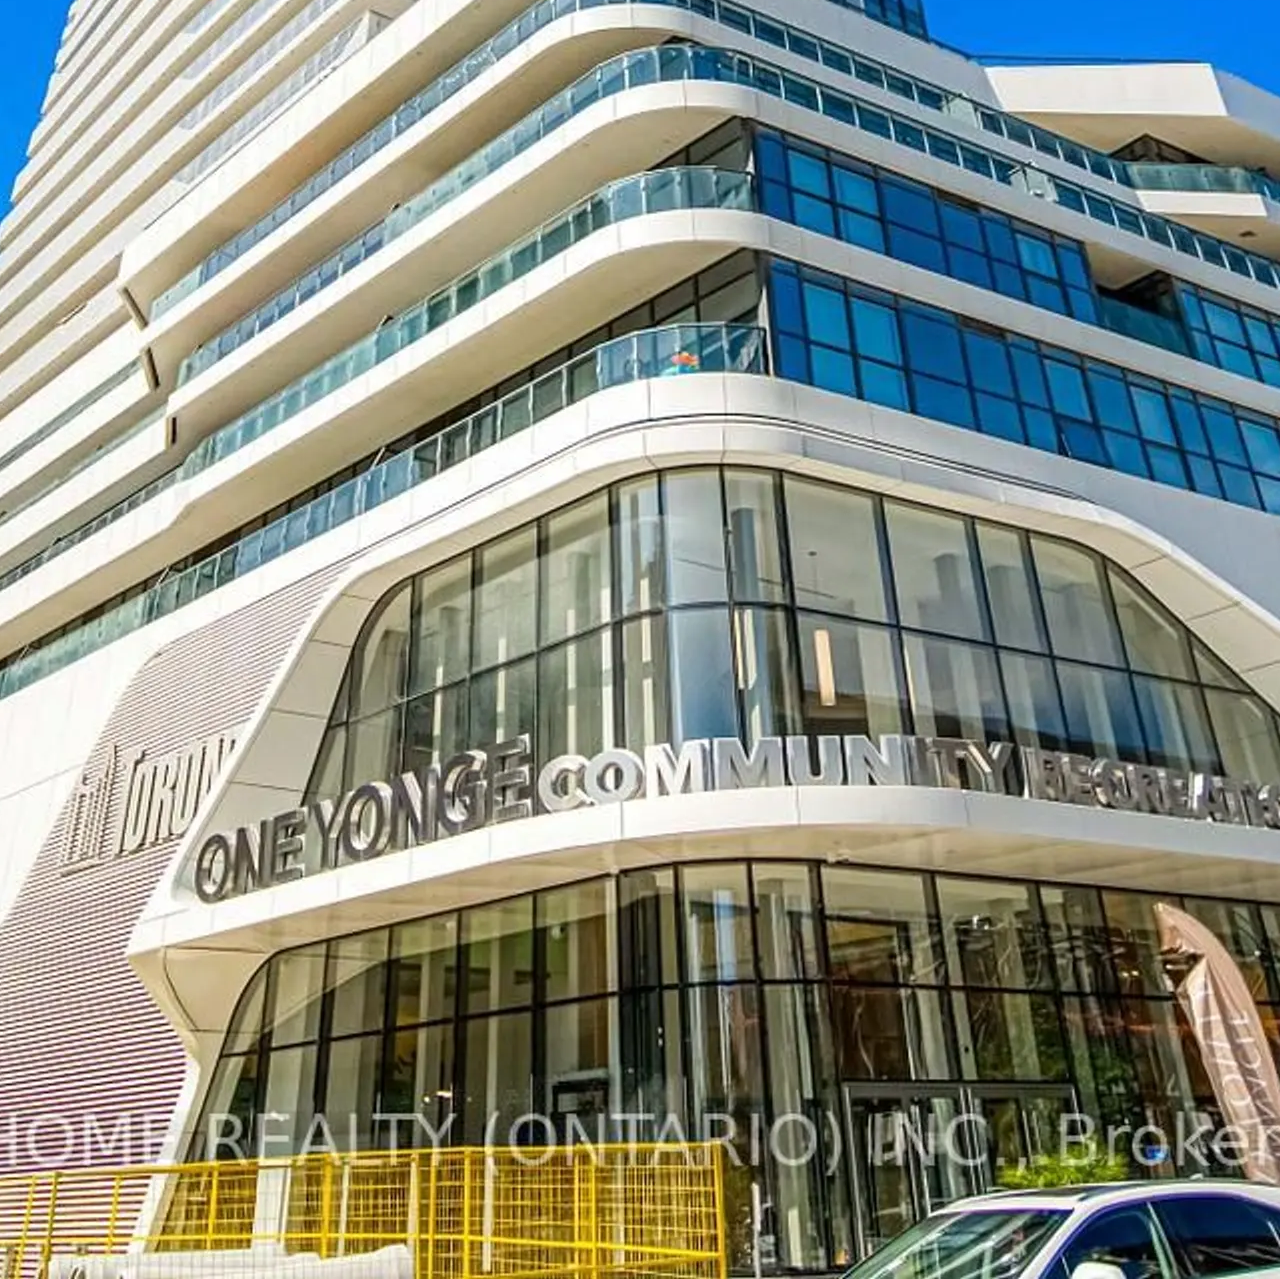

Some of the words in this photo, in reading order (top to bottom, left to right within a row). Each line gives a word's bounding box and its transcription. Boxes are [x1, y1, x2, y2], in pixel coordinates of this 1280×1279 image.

[115, 735, 242, 858] TORON
[195, 807, 307, 904] ONE
[307, 733, 537, 871] YONGE
[538, 735, 1014, 813] COMMUNITY
